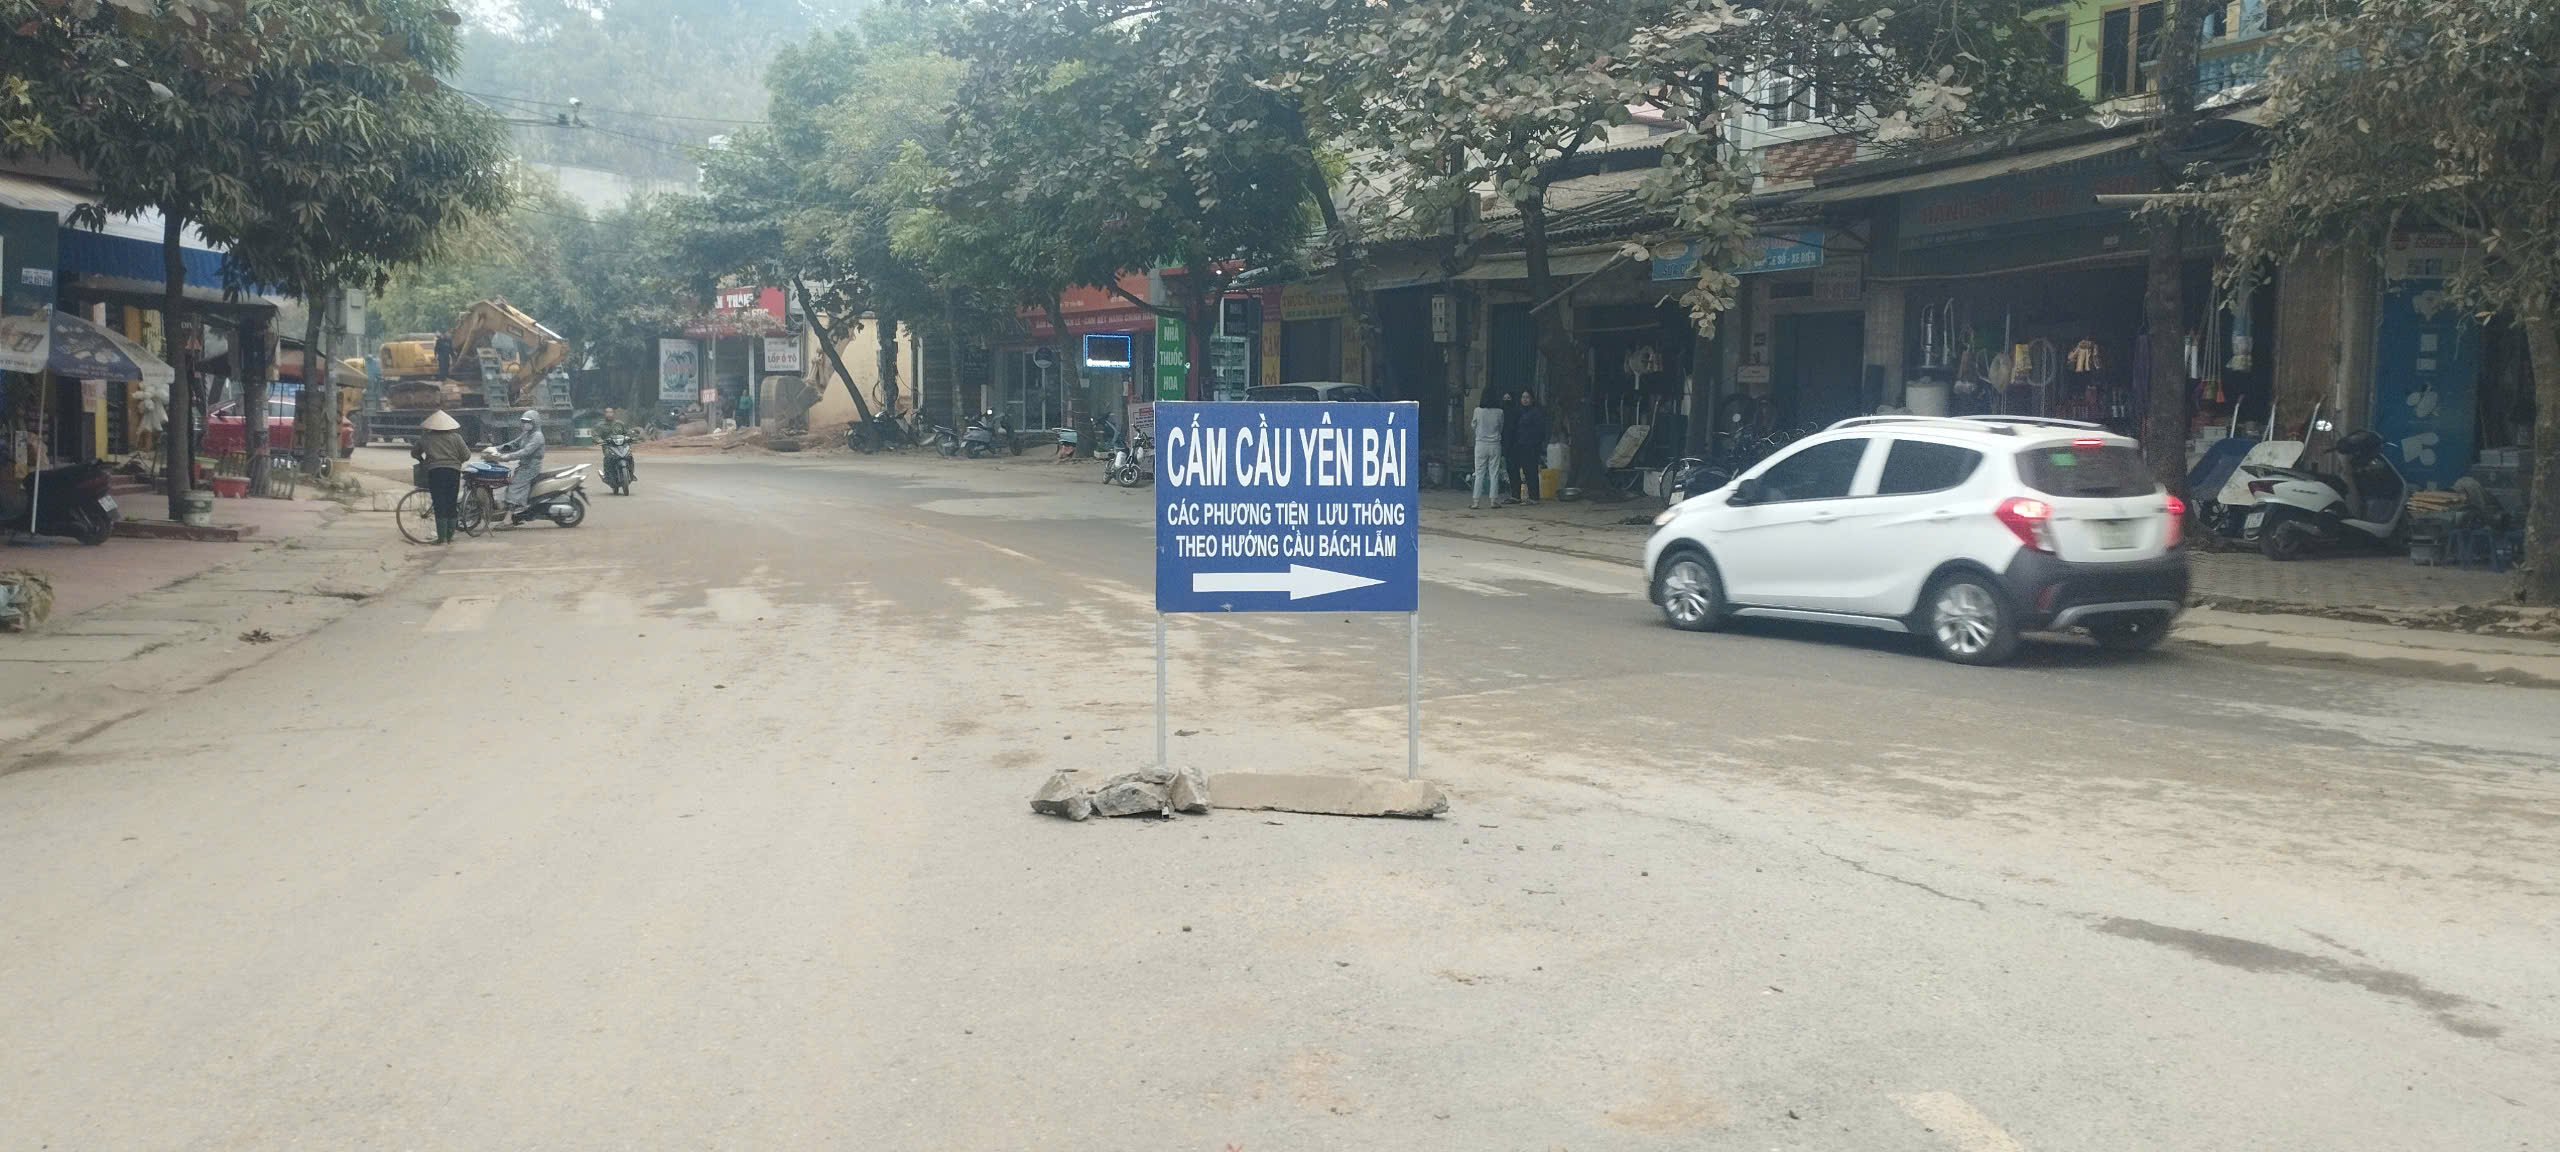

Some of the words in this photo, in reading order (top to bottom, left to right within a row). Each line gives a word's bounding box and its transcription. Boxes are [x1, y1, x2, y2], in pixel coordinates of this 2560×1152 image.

[1777, 251, 1786, 265] SỐ
[1791, 253, 1800, 263] XE
[1164, 323, 1179, 341] NHÀ
[1160, 346, 1183, 366] THUỐC
[1163, 376, 1178, 391] HOA
[1167, 413, 1227, 487] CẤM
[1235, 412, 1291, 487] CẦU
[1299, 411, 1352, 487] YÊN
[1362, 412, 1406, 487] BÁI
[1167, 498, 1200, 526] CÁC
[1204, 501, 1271, 526] PHƯƠNG
[1275, 501, 1309, 530] TIỆN
[1317, 502, 1349, 526] LƯU
[1352, 498, 1405, 526] THÔNG
[1176, 534, 1218, 557] THEO
[1221, 530, 1279, 557] HƯỚNG
[1283, 530, 1314, 557] CẦU
[1319, 530, 1361, 557] BÁCH
[1365, 530, 1396, 557] LẪM
